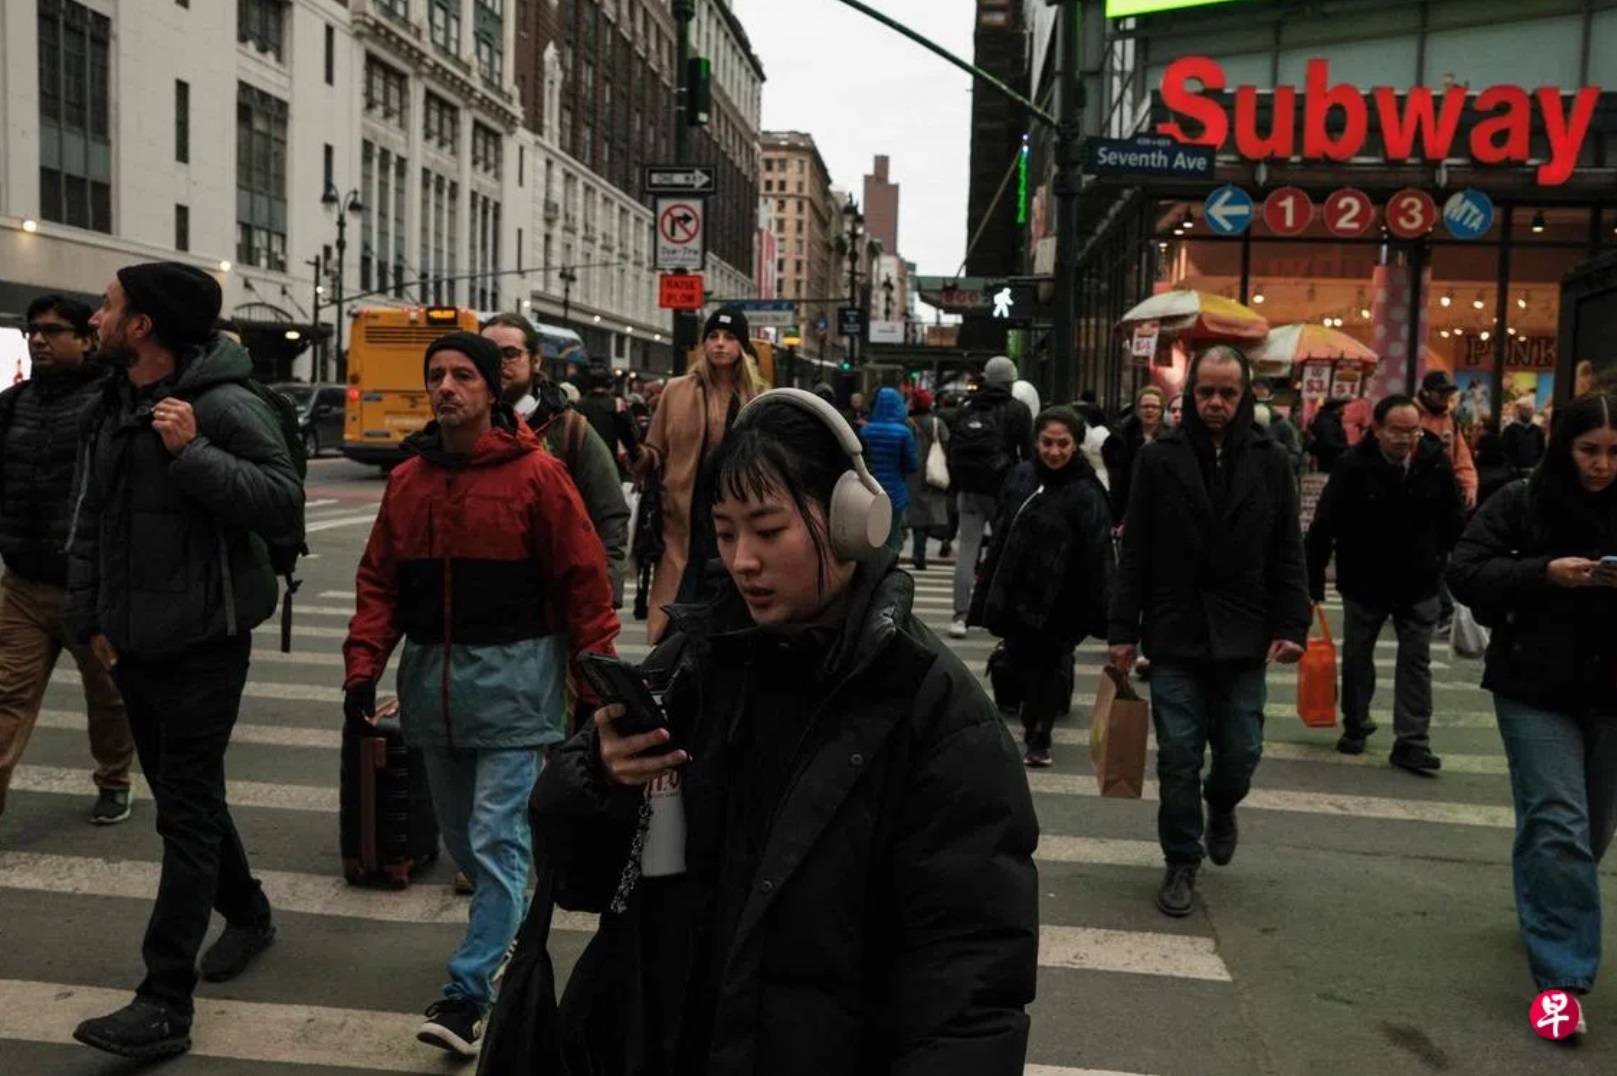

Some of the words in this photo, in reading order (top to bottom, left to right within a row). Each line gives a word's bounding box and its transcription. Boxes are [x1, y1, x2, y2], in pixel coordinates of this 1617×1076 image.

[1156, 55, 1601, 186] Subway
[1097, 147, 1170, 169] Seventh
[1172, 151, 1208, 172] Ave
[1277, 195, 1295, 228] 1
[1335, 196, 1361, 229] 2
[1398, 197, 1424, 230] 3
[1445, 192, 1485, 233] MTA
[1466, 335, 1557, 367] PNK
